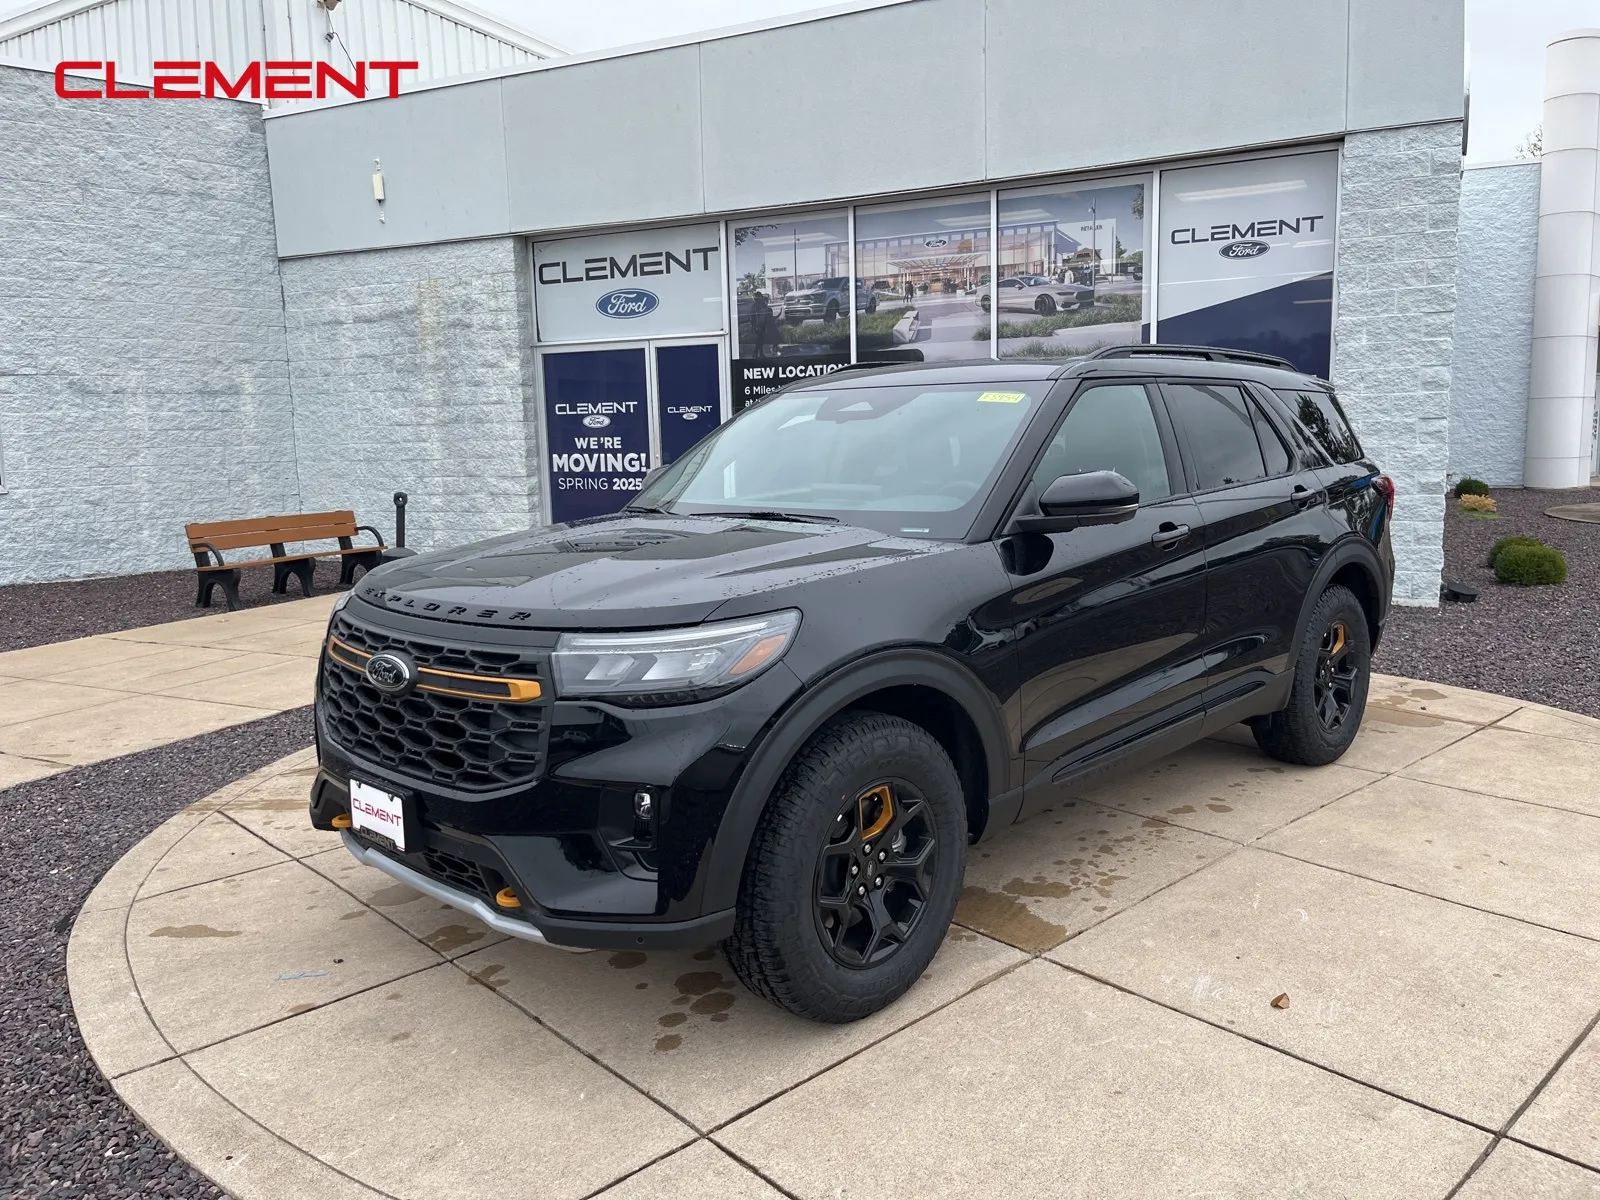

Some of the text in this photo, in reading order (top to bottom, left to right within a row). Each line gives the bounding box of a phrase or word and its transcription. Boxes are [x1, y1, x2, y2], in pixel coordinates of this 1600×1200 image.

[1171, 215, 1324, 245] CLEMENT
[538, 246, 719, 285] CLEMENT
[607, 292, 647, 315] Ford
[743, 367, 775, 379] NEW
[744, 386, 751, 395] 6
[753, 385, 776, 395] Miles
[555, 401, 638, 415] CLEMENT
[667, 405, 713, 414] CLEMENT
[552, 453, 647, 473] MOVING!
[558, 477, 643, 491] SPRING 2025
[363, 587, 532, 621] EXPLORER
[352, 797, 402, 827] CLEMENT
